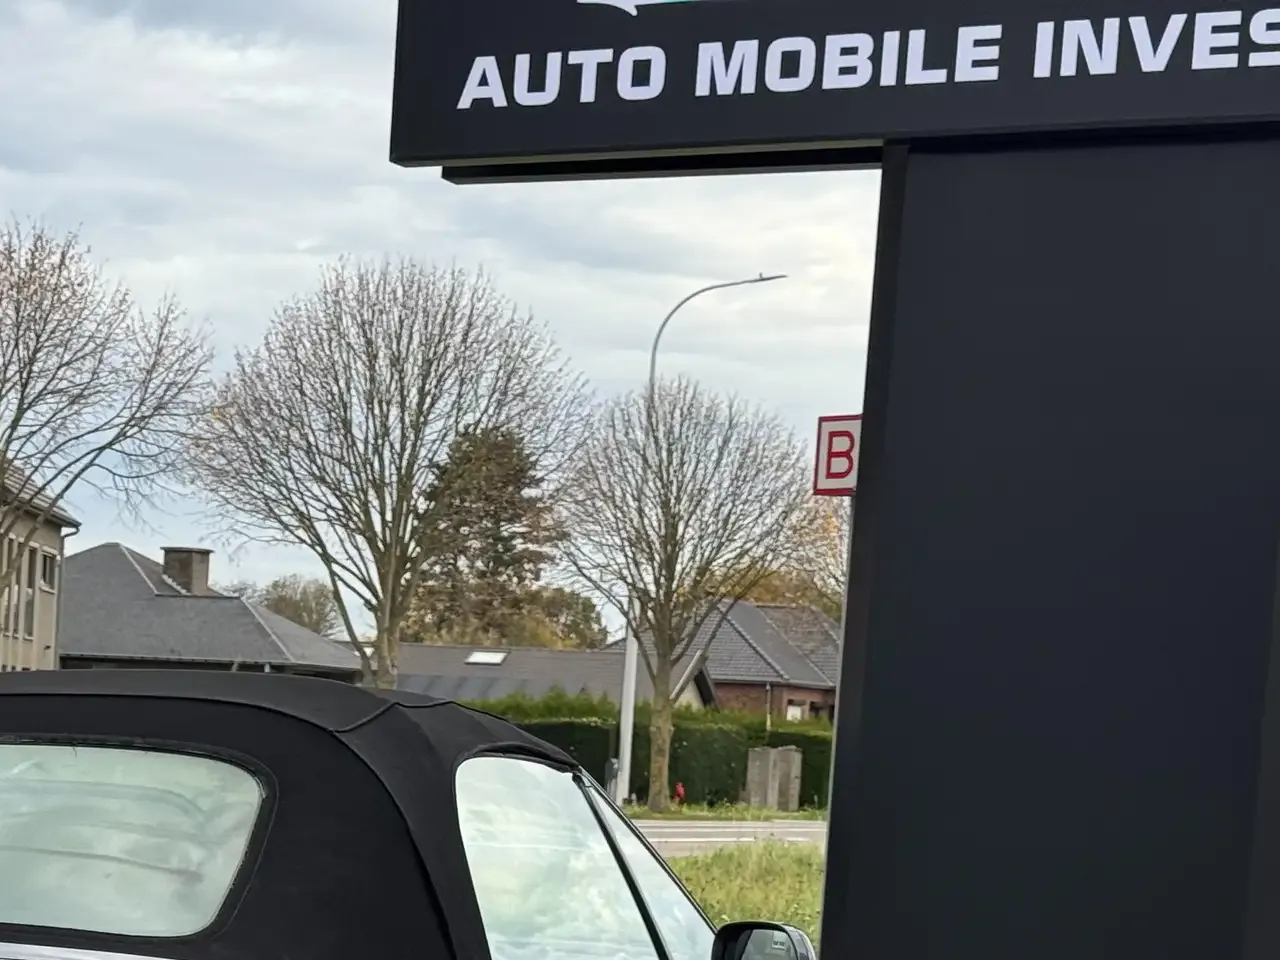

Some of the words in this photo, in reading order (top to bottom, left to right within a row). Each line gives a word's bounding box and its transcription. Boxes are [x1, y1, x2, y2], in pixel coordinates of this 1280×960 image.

[456, 45, 667, 110] AUTO
[694, 24, 1003, 98] MOBILE
[1032, 8, 1280, 79] INVES
[825, 430, 855, 480] B
